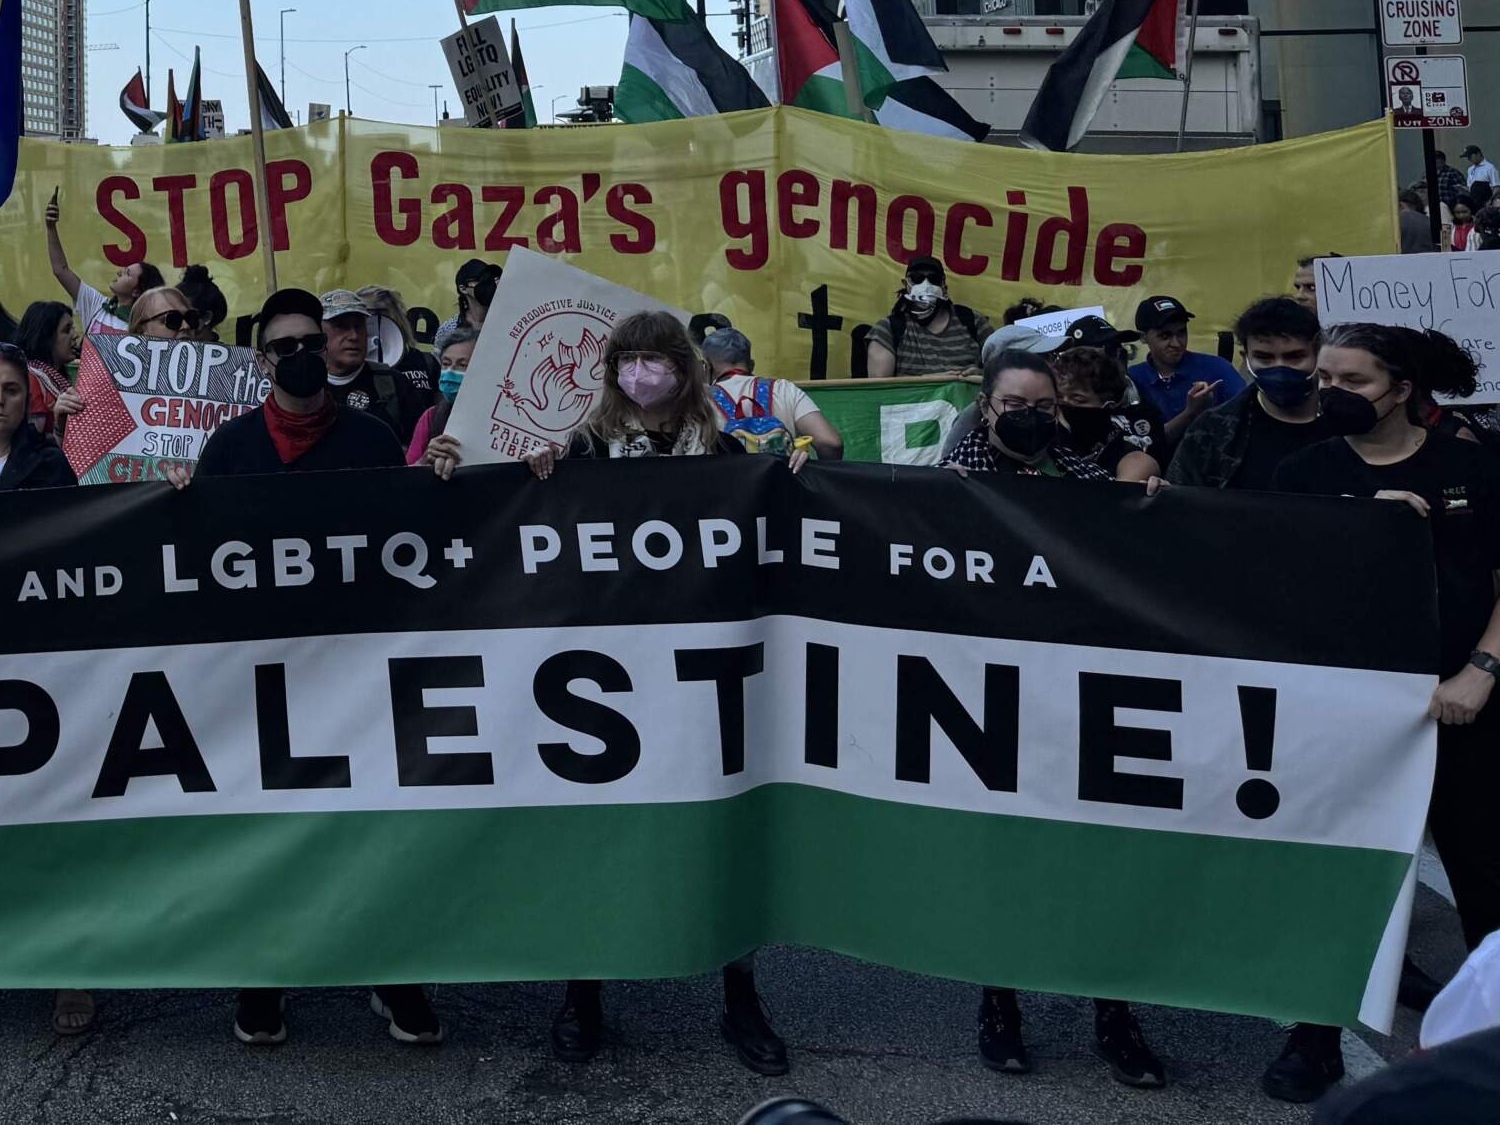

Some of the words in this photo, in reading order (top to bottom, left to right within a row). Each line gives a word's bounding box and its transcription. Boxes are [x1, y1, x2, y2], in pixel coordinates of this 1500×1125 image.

[1386, 0, 1455, 18] CRUISING
[1403, 20, 1442, 38] ZONE
[457, 43, 499, 78] LGTQ
[1428, 116, 1463, 126] ZONE
[96, 158, 312, 269] STOP
[370, 151, 656, 256] Gaza's
[719, 168, 1147, 288] genocide
[1321, 260, 1434, 331] Money
[509, 298, 573, 340] REPRODUCTIVE
[576, 299, 618, 322] JUSTICE
[1037, 322, 1062, 337] hoose
[113, 336, 230, 397] STOP
[232, 362, 272, 404] the
[141, 431, 194, 458] STOP
[17, 565, 124, 602] AND
[162, 532, 474, 593] LGBTQ+
[518, 516, 842, 574] PEOPLE
[890, 543, 997, 584] FOR
[1022, 554, 1058, 589] A
